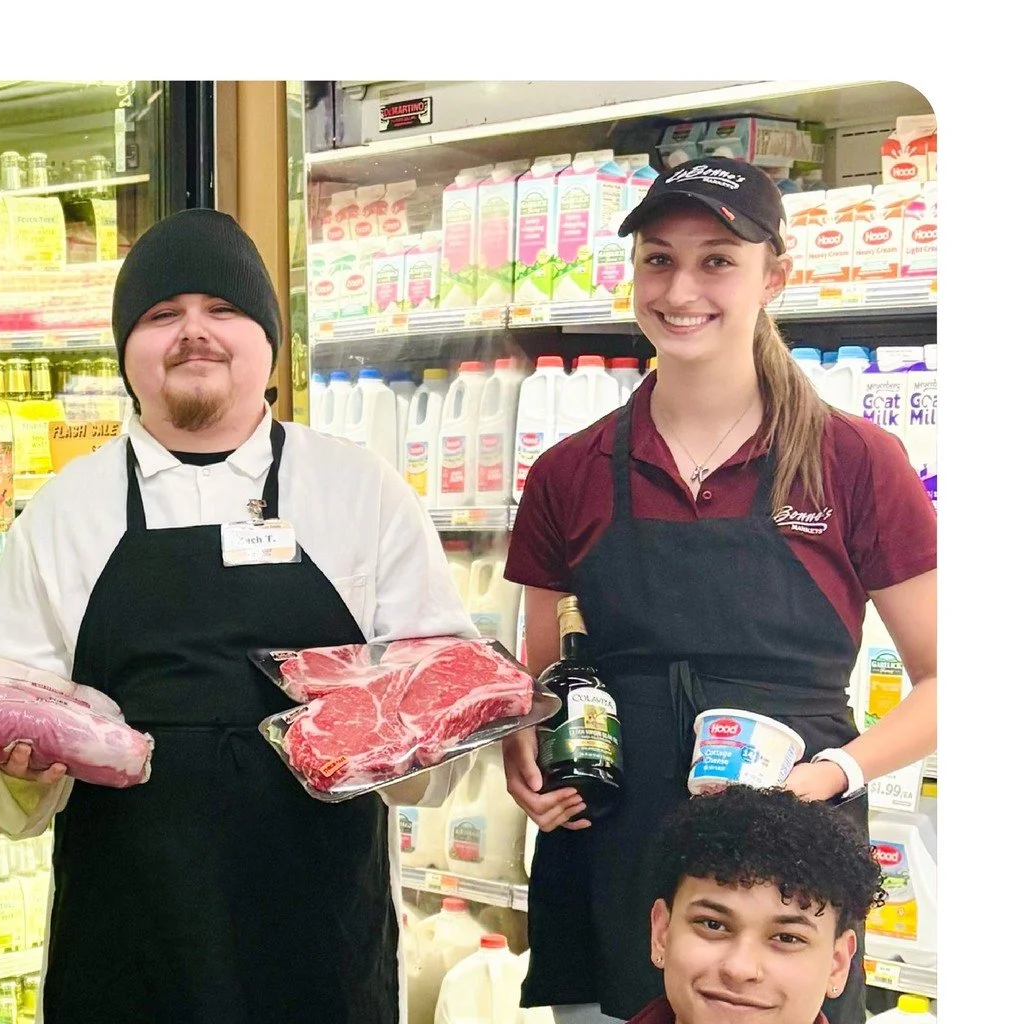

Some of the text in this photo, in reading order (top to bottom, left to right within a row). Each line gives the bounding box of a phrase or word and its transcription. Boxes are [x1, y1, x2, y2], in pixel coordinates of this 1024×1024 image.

[892, 166, 916, 176] Hood
[818, 235, 842, 246] Hood
[864, 230, 890, 242] Hood
[914, 379, 937, 390] Meyenb
[863, 393, 901, 409] Goat
[910, 392, 937, 409] Goa
[910, 410, 936, 425] Mil
[53, 424, 119, 439] FLASH SALE
[773, 505, 834, 523] Bonne's
[265, 534, 277, 543] T.
[571, 694, 614, 709] COLAVITA
[709, 723, 739, 735] Hood
[704, 748, 733, 758] Cottage
[703, 757, 729, 765] Cheese
